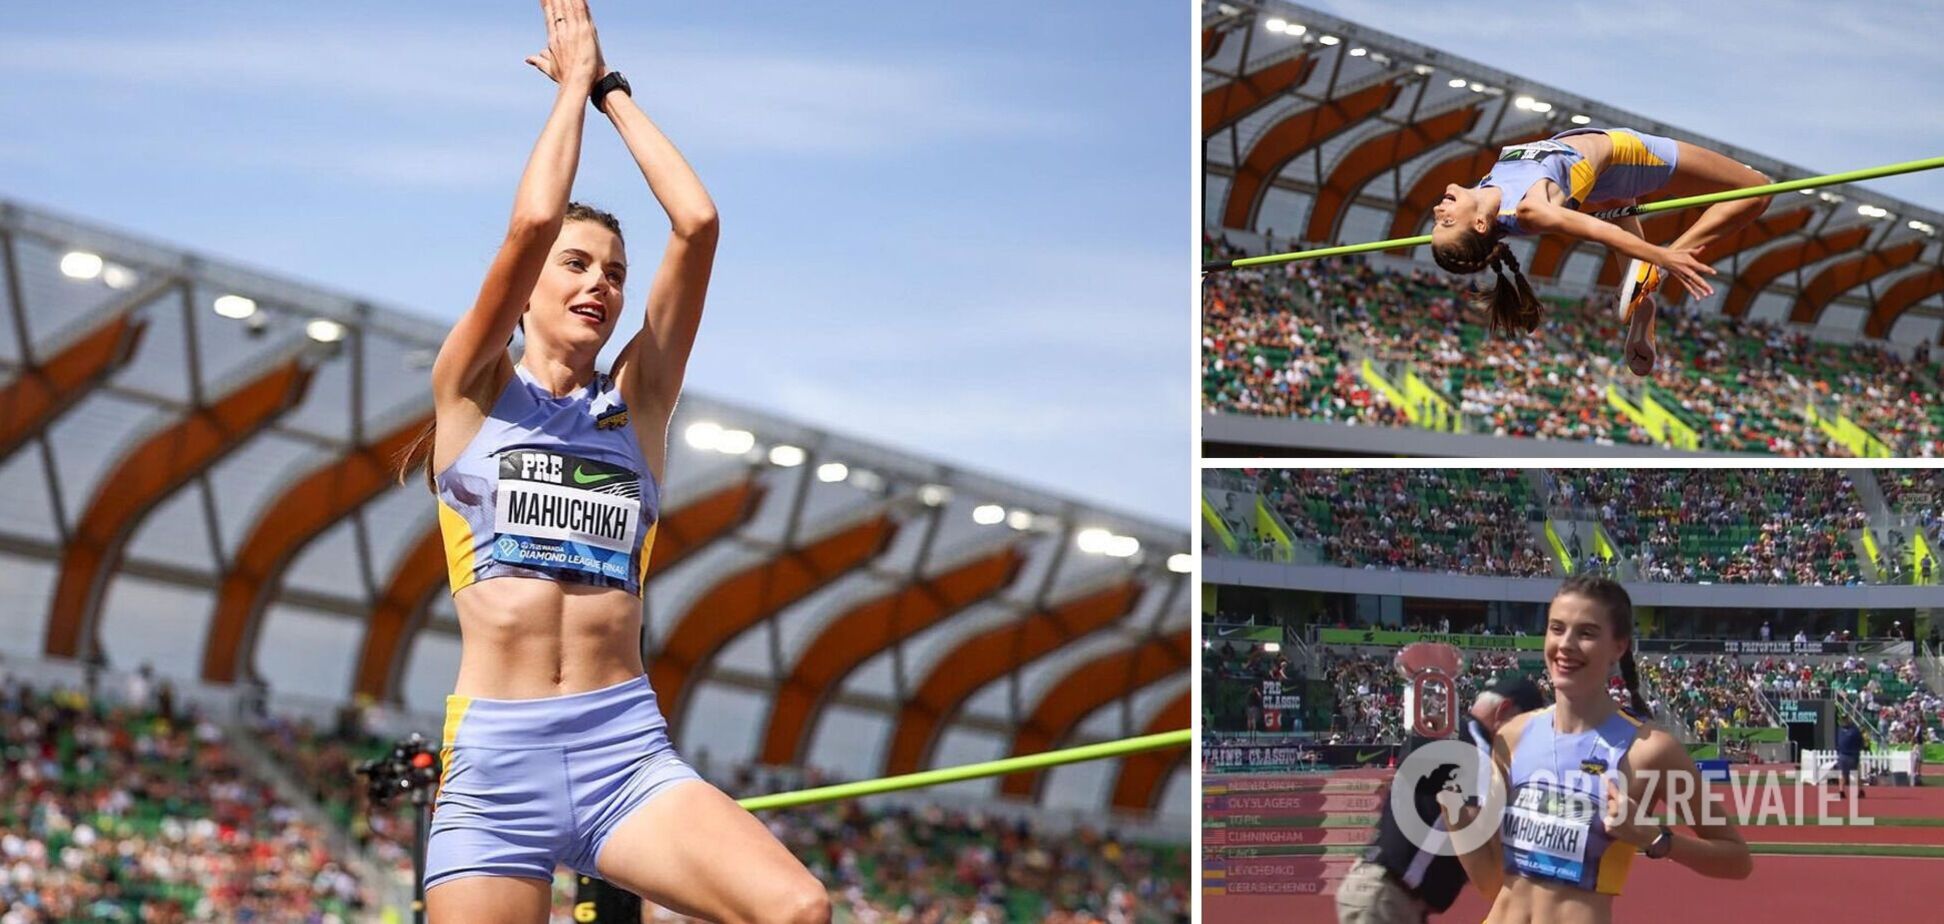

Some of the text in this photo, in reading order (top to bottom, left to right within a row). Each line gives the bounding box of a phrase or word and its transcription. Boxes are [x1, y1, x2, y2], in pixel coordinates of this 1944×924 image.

[520, 453, 563, 484] PRE
[507, 490, 629, 541] MAHUCHIKH
[520, 550, 625, 574] DIAMOND LEAGUE FINAL
[1263, 681, 1281, 695] PRE
[1263, 695, 1300, 709] CLASSIC
[1514, 788, 1544, 809] PRE
[1503, 813, 1579, 853] MAHUCHIKH
[574, 902, 597, 923] 6
